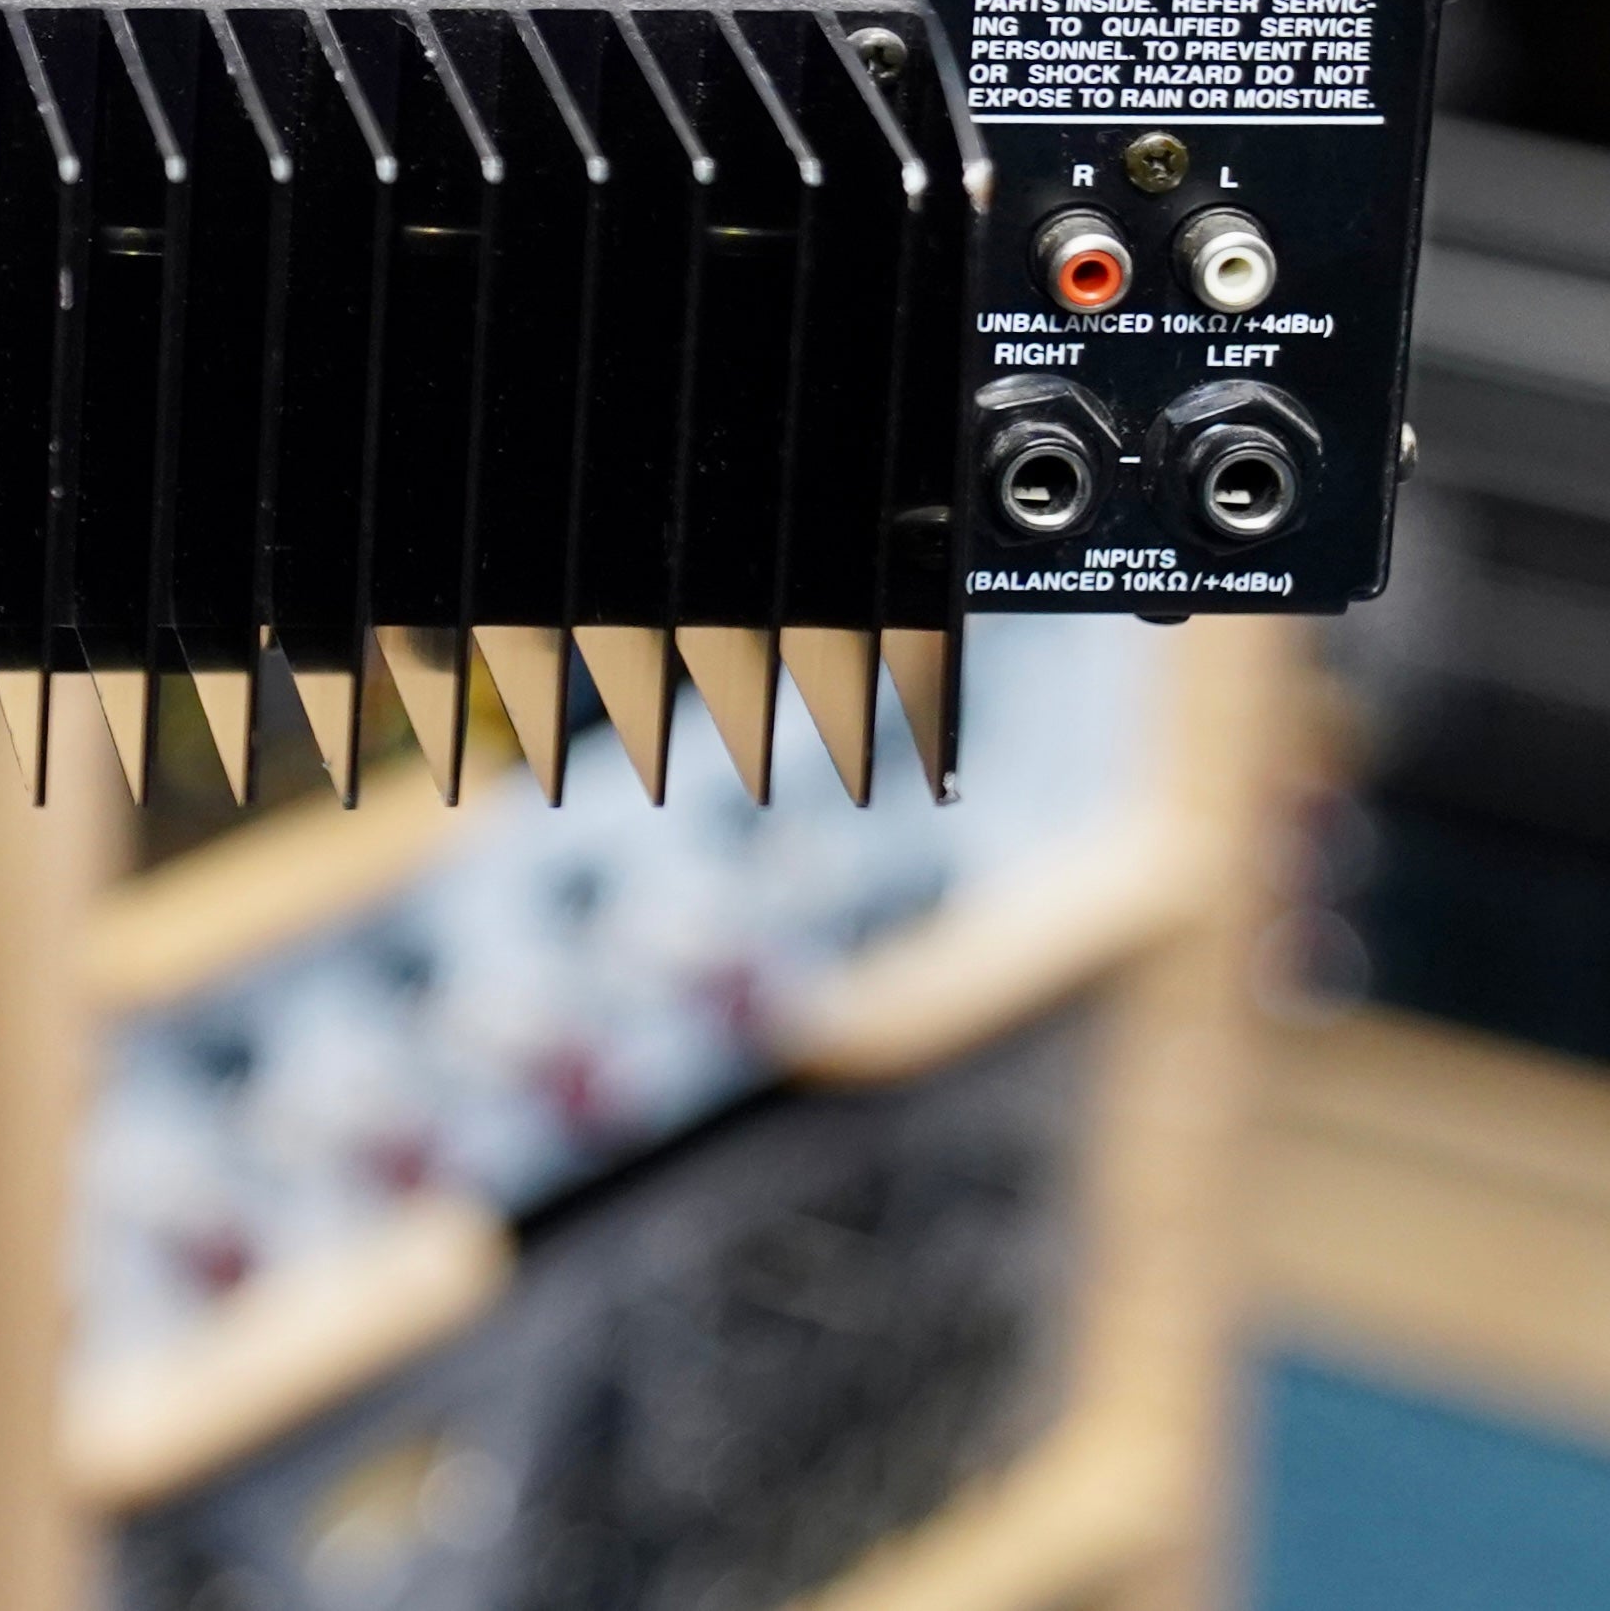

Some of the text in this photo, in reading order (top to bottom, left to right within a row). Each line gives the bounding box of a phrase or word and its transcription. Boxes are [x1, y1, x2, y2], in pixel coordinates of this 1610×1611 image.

[973, 16, 1373, 37] ING TO QUALIFIED SERVICE
[971, 40, 1370, 61] PERSONNEL. TO PREVENT FIRE
[969, 64, 1370, 85] OR SHOCK HAZARD DO NOT
[966, 88, 1375, 110] EXPOSE TO RAIN OR MOISTURE.
[1073, 165, 1094, 186] R
[1220, 166, 1238, 188] L
[995, 343, 1084, 365] RIGHT
[1207, 345, 1280, 367] LEFT
[1085, 549, 1176, 569] INPUTS
[966, 571, 1114, 594] (BALANCED
